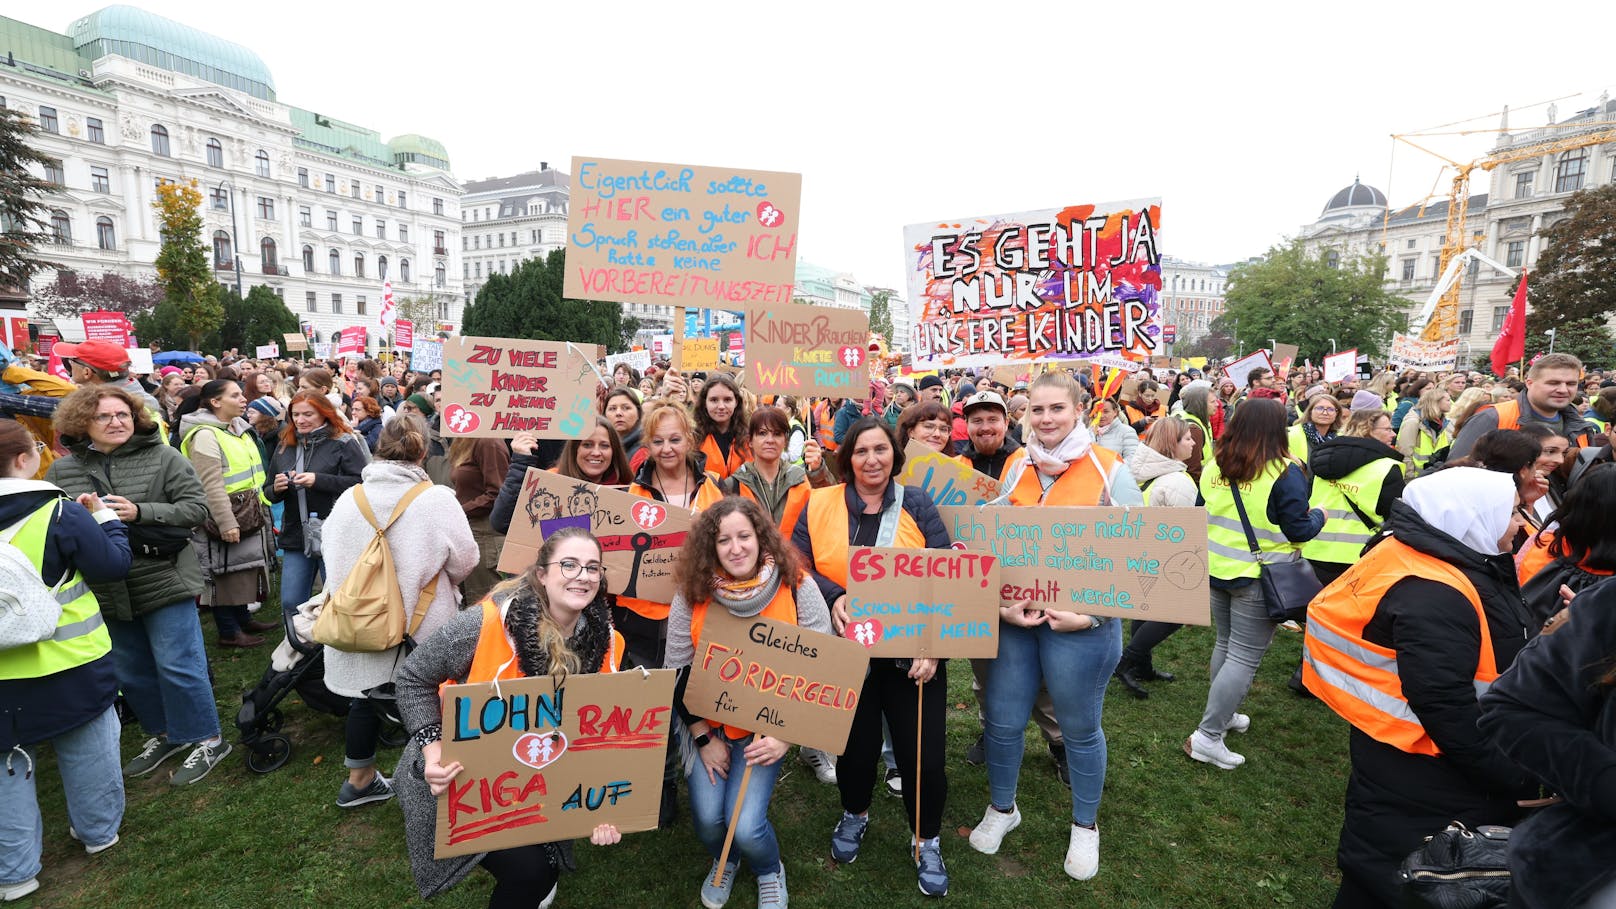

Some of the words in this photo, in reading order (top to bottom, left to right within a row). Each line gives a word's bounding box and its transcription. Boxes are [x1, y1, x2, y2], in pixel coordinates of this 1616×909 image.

[579, 163, 694, 198] Eigentlich
[581, 197, 656, 221] HIER
[661, 207, 690, 223] ein
[698, 204, 750, 234] guter
[572, 223, 637, 253] Spruch
[746, 233, 796, 261] ICH
[932, 233, 982, 279] ES
[994, 215, 1109, 273] GEHT
[1111, 208, 1160, 267] JA
[1063, 270, 1113, 310] UM
[1026, 298, 1157, 354] KINDER
[467, 344, 501, 365] ZU
[509, 349, 557, 368] VIELE
[754, 360, 801, 389] WIR
[470, 392, 497, 406] ZU
[507, 394, 557, 410] WENIG
[491, 411, 552, 431] HÄNDE
[954, 514, 986, 541] Ich
[995, 513, 1042, 539] kann
[1051, 521, 1086, 551] gar
[1095, 512, 1145, 539] nicht
[1155, 523, 1185, 543] so
[849, 548, 886, 582] ES
[894, 553, 996, 588] REICHT!
[1045, 546, 1113, 571] arbeiten
[1126, 551, 1160, 575] wie
[1000, 579, 1060, 602] ezahlt
[1070, 584, 1134, 609] werde
[749, 622, 818, 658] Gleiches
[939, 621, 992, 640] MEHR
[703, 642, 857, 711] FÖRDERGELD
[452, 688, 565, 742] LOHN
[577, 704, 671, 737] RAUF
[714, 691, 739, 713] für
[756, 706, 785, 727] Alle
[448, 770, 547, 829] KIGA
[561, 781, 632, 811] AUF
